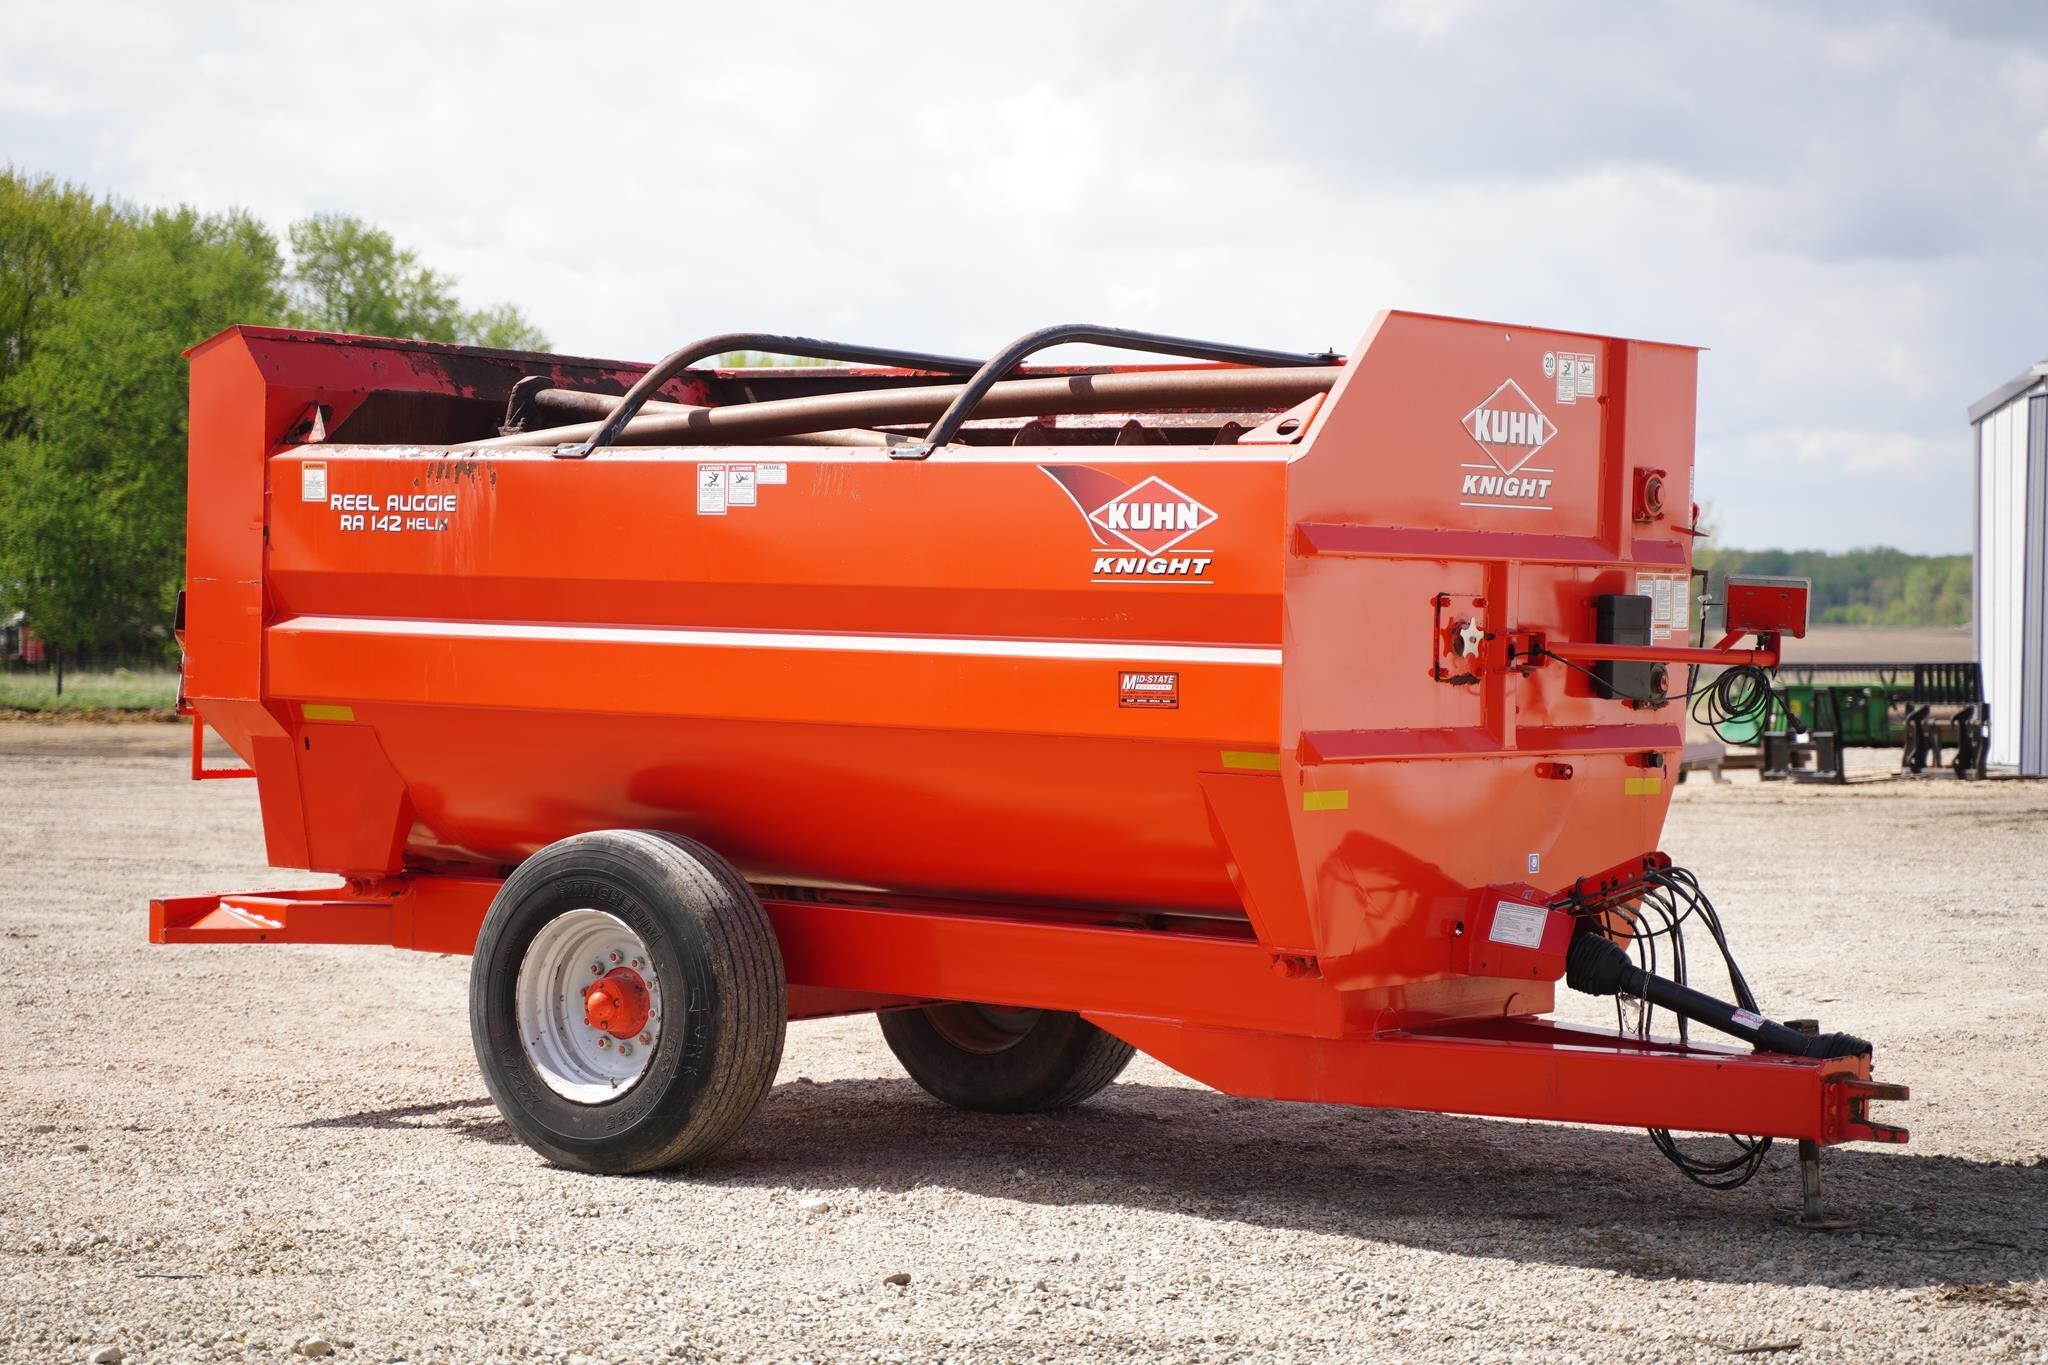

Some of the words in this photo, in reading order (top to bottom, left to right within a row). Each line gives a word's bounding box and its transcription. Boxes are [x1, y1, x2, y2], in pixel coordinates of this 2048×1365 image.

[1545, 357, 1554, 368] 20
[1474, 408, 1545, 446] KUHN
[1462, 475, 1552, 499] KNIGHT
[330, 494, 380, 512] REEL
[386, 494, 457, 512] AUGGIE
[340, 514, 364, 531] RA
[371, 515, 402, 532] 142
[406, 517, 448, 531] HELIX
[1108, 502, 1199, 531] KUHN
[1093, 557, 1213, 576] KNIGHT
[1122, 674, 1175, 690] MID-STATE
